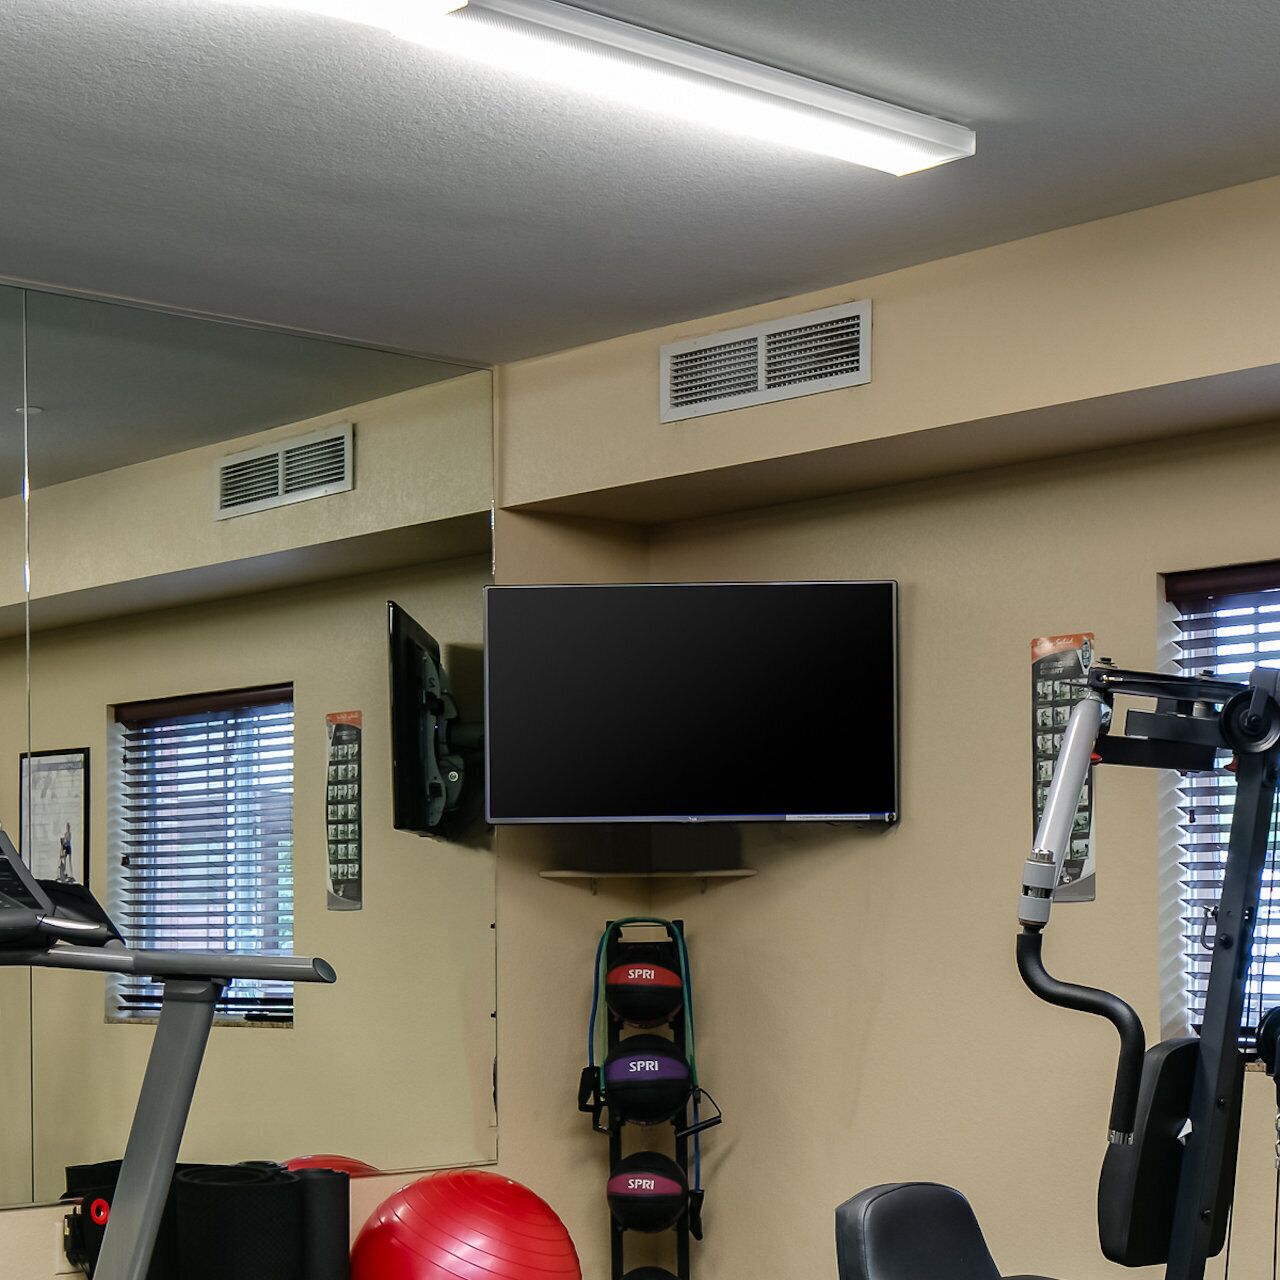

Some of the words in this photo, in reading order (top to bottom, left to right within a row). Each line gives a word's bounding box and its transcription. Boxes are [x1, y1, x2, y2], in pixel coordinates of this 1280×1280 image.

[628, 969, 655, 980] SPRI
[628, 1060, 659, 1072] SPRI
[627, 1178, 655, 1190] SPRI
